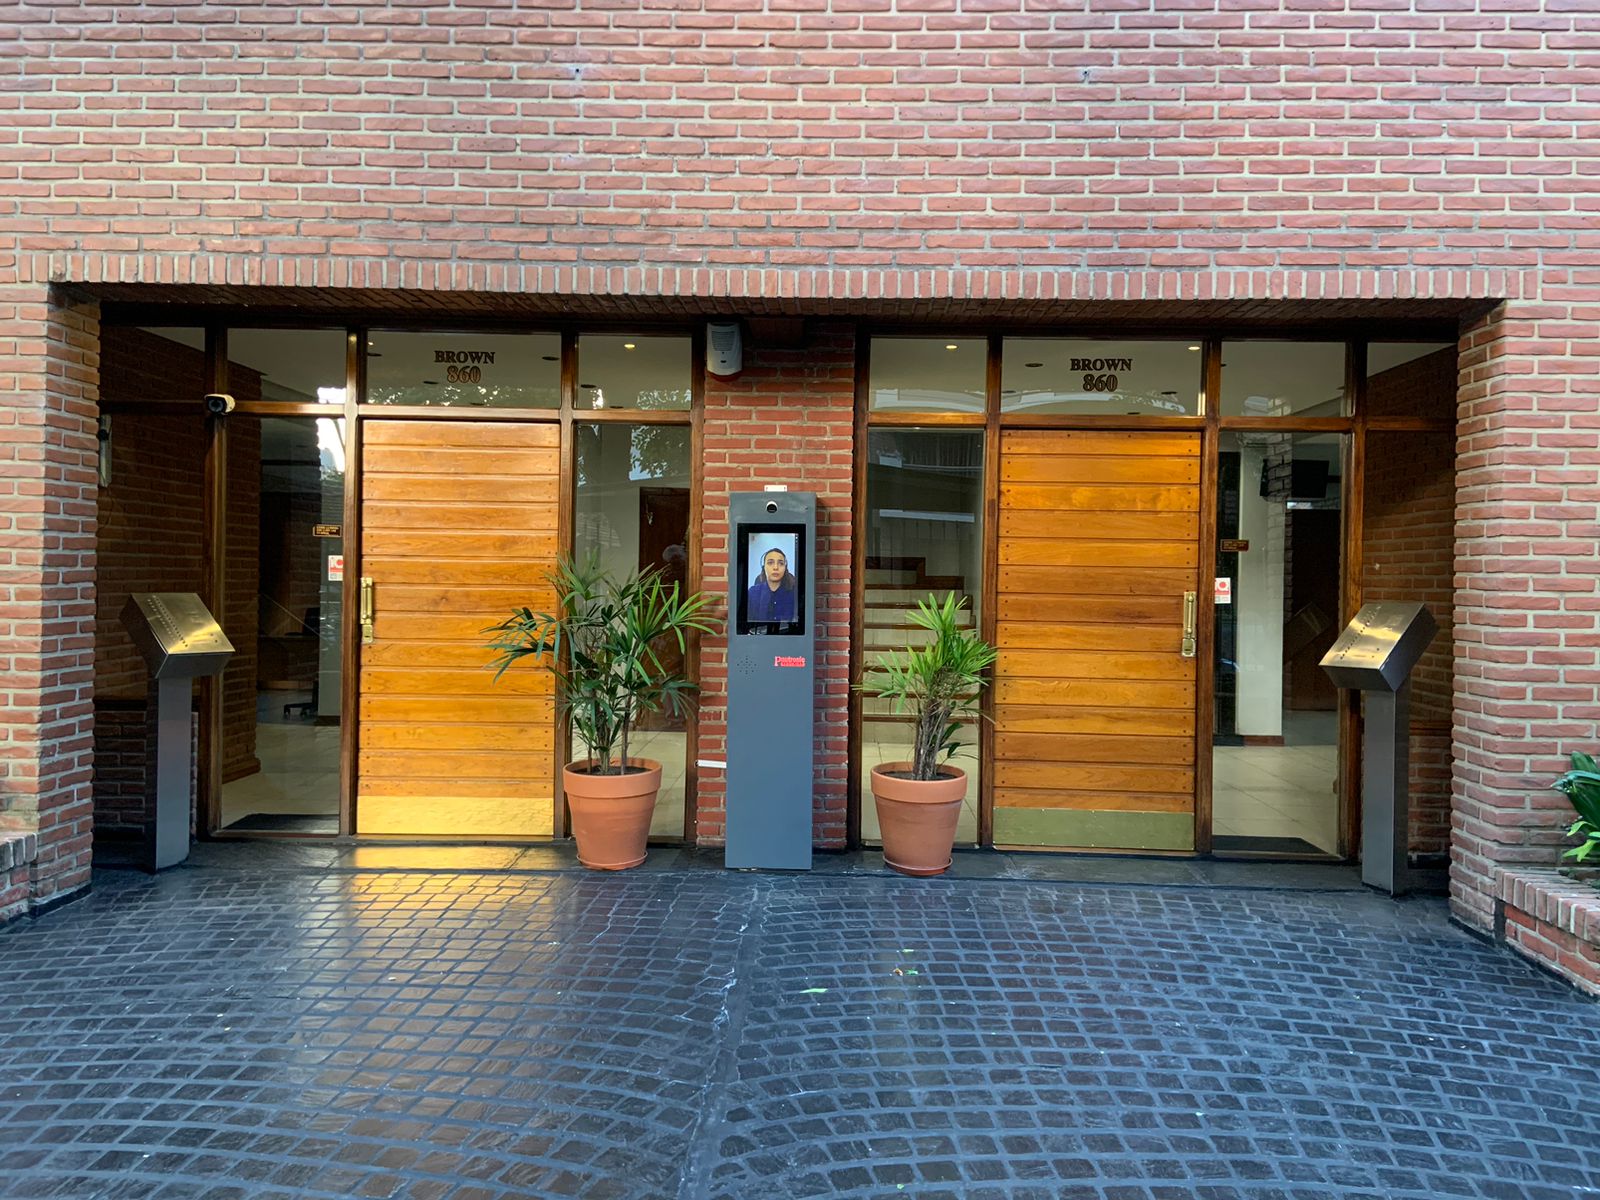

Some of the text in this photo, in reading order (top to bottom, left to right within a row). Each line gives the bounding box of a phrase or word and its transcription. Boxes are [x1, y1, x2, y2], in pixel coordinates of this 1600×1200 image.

[434, 350, 495, 364] BROWN
[1070, 358, 1133, 371] BROWN
[447, 365, 481, 384] 860
[1083, 373, 1118, 392] 860
